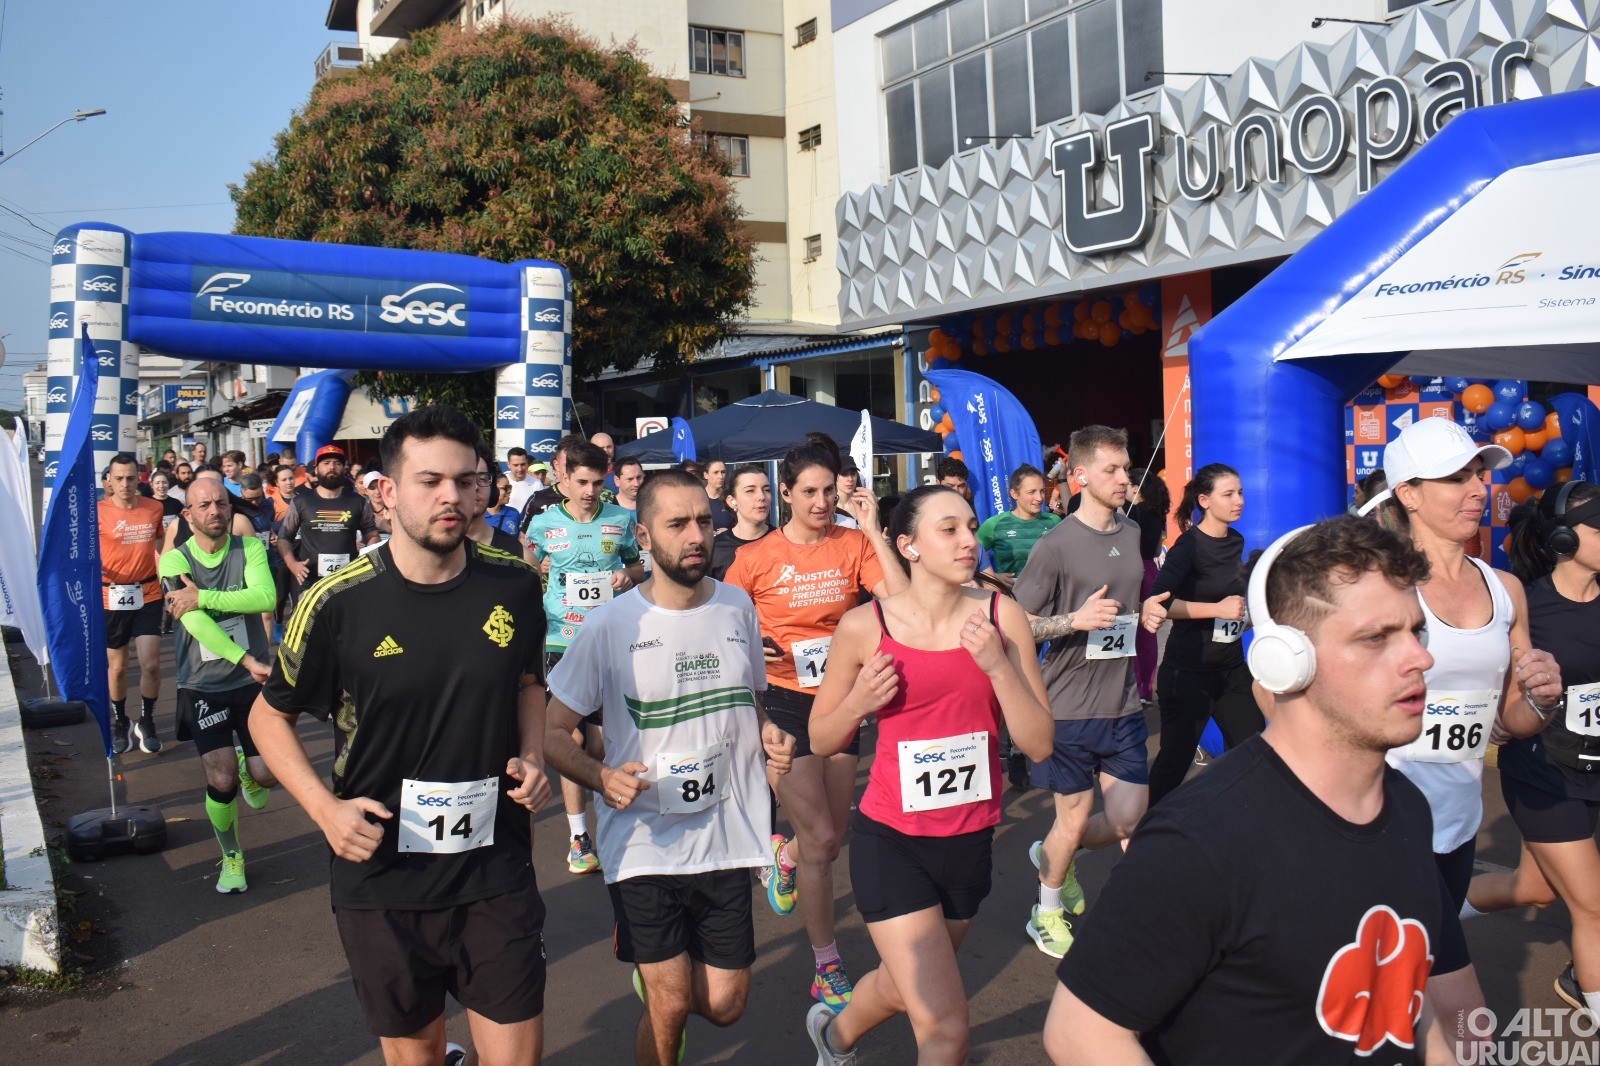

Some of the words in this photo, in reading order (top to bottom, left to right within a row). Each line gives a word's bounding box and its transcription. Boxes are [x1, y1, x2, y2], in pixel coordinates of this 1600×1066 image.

[1176, 39, 1536, 201] unopar
[82, 279, 117, 292] Sesc
[1375, 274, 1490, 297] Fecomércio
[1495, 270, 1525, 285] RS
[210, 296, 323, 319] Fecomércio
[328, 304, 354, 321] RS
[1538, 297, 1596, 308] Sistema
[379, 294, 465, 327] Sesc
[535, 311, 560, 323] Sesc
[532, 377, 559, 388] Sesc
[497, 410, 520, 420] Sesc
[69, 485, 79, 560] Sindicatos
[88, 525, 96, 560] Sistema
[794, 567, 842, 584] RÚSTICA
[74, 580, 83, 600] RS
[792, 583, 816, 593] ANOS
[818, 578, 849, 590] UNOPAR
[118, 596, 135, 605] 44
[578, 587, 601, 600] 03
[788, 593, 846, 609] WESTPHALEN
[792, 587, 840, 600] FREDERICO
[1101, 634, 1125, 651] 24
[373, 646, 403, 658] adidas
[803, 647, 824, 656] Sesc
[1426, 703, 1460, 716] Sesc
[1425, 723, 1484, 751] 186
[913, 751, 946, 764] Sesc
[670, 762, 700, 775] Sesc
[682, 772, 716, 803] 84
[916, 763, 977, 797] 127
[416, 794, 453, 807] Sesc
[428, 812, 473, 841] 14
